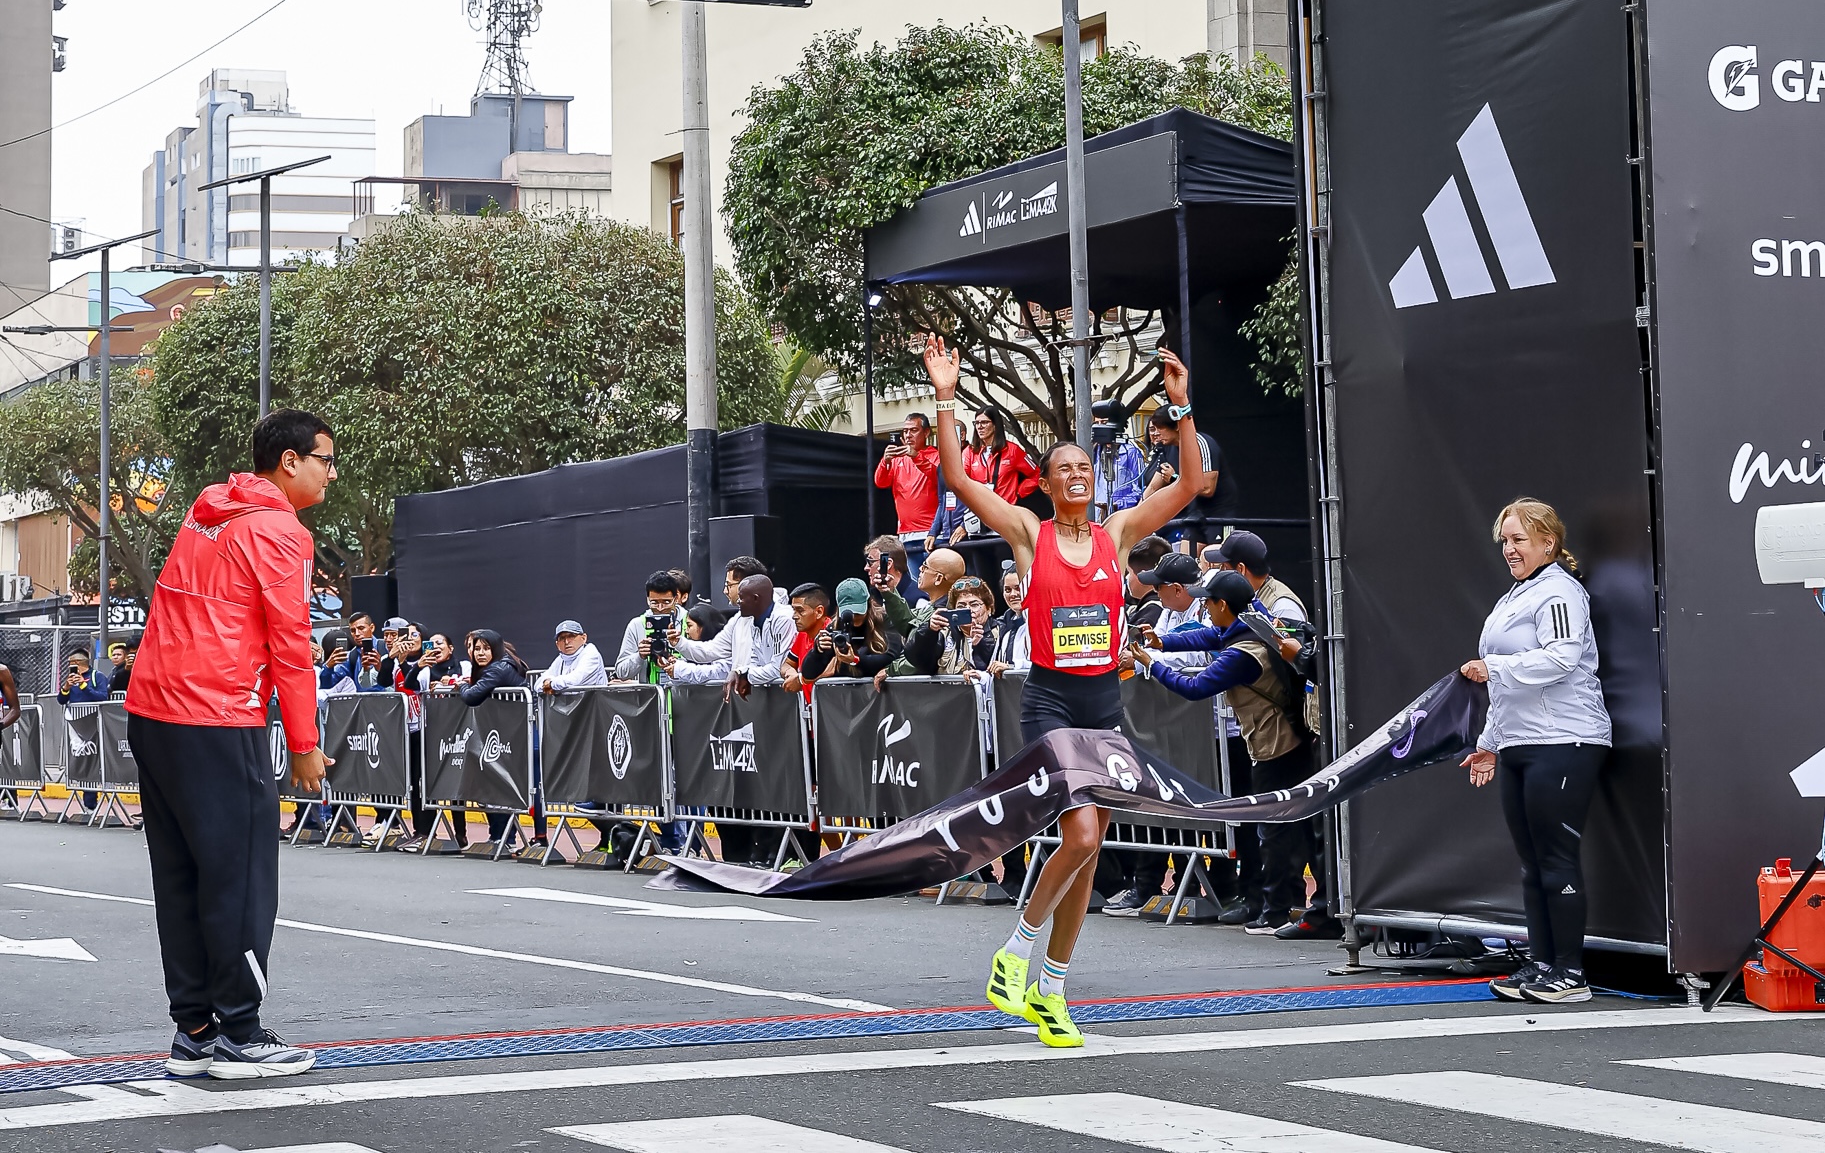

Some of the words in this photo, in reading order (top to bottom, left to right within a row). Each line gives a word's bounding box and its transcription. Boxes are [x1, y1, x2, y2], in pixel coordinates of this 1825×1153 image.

[1771, 59, 1825, 102] GA
[986, 210, 1017, 229] RIMAC
[1752, 238, 1825, 278] sm
[1059, 632, 1108, 647] DEMISSE
